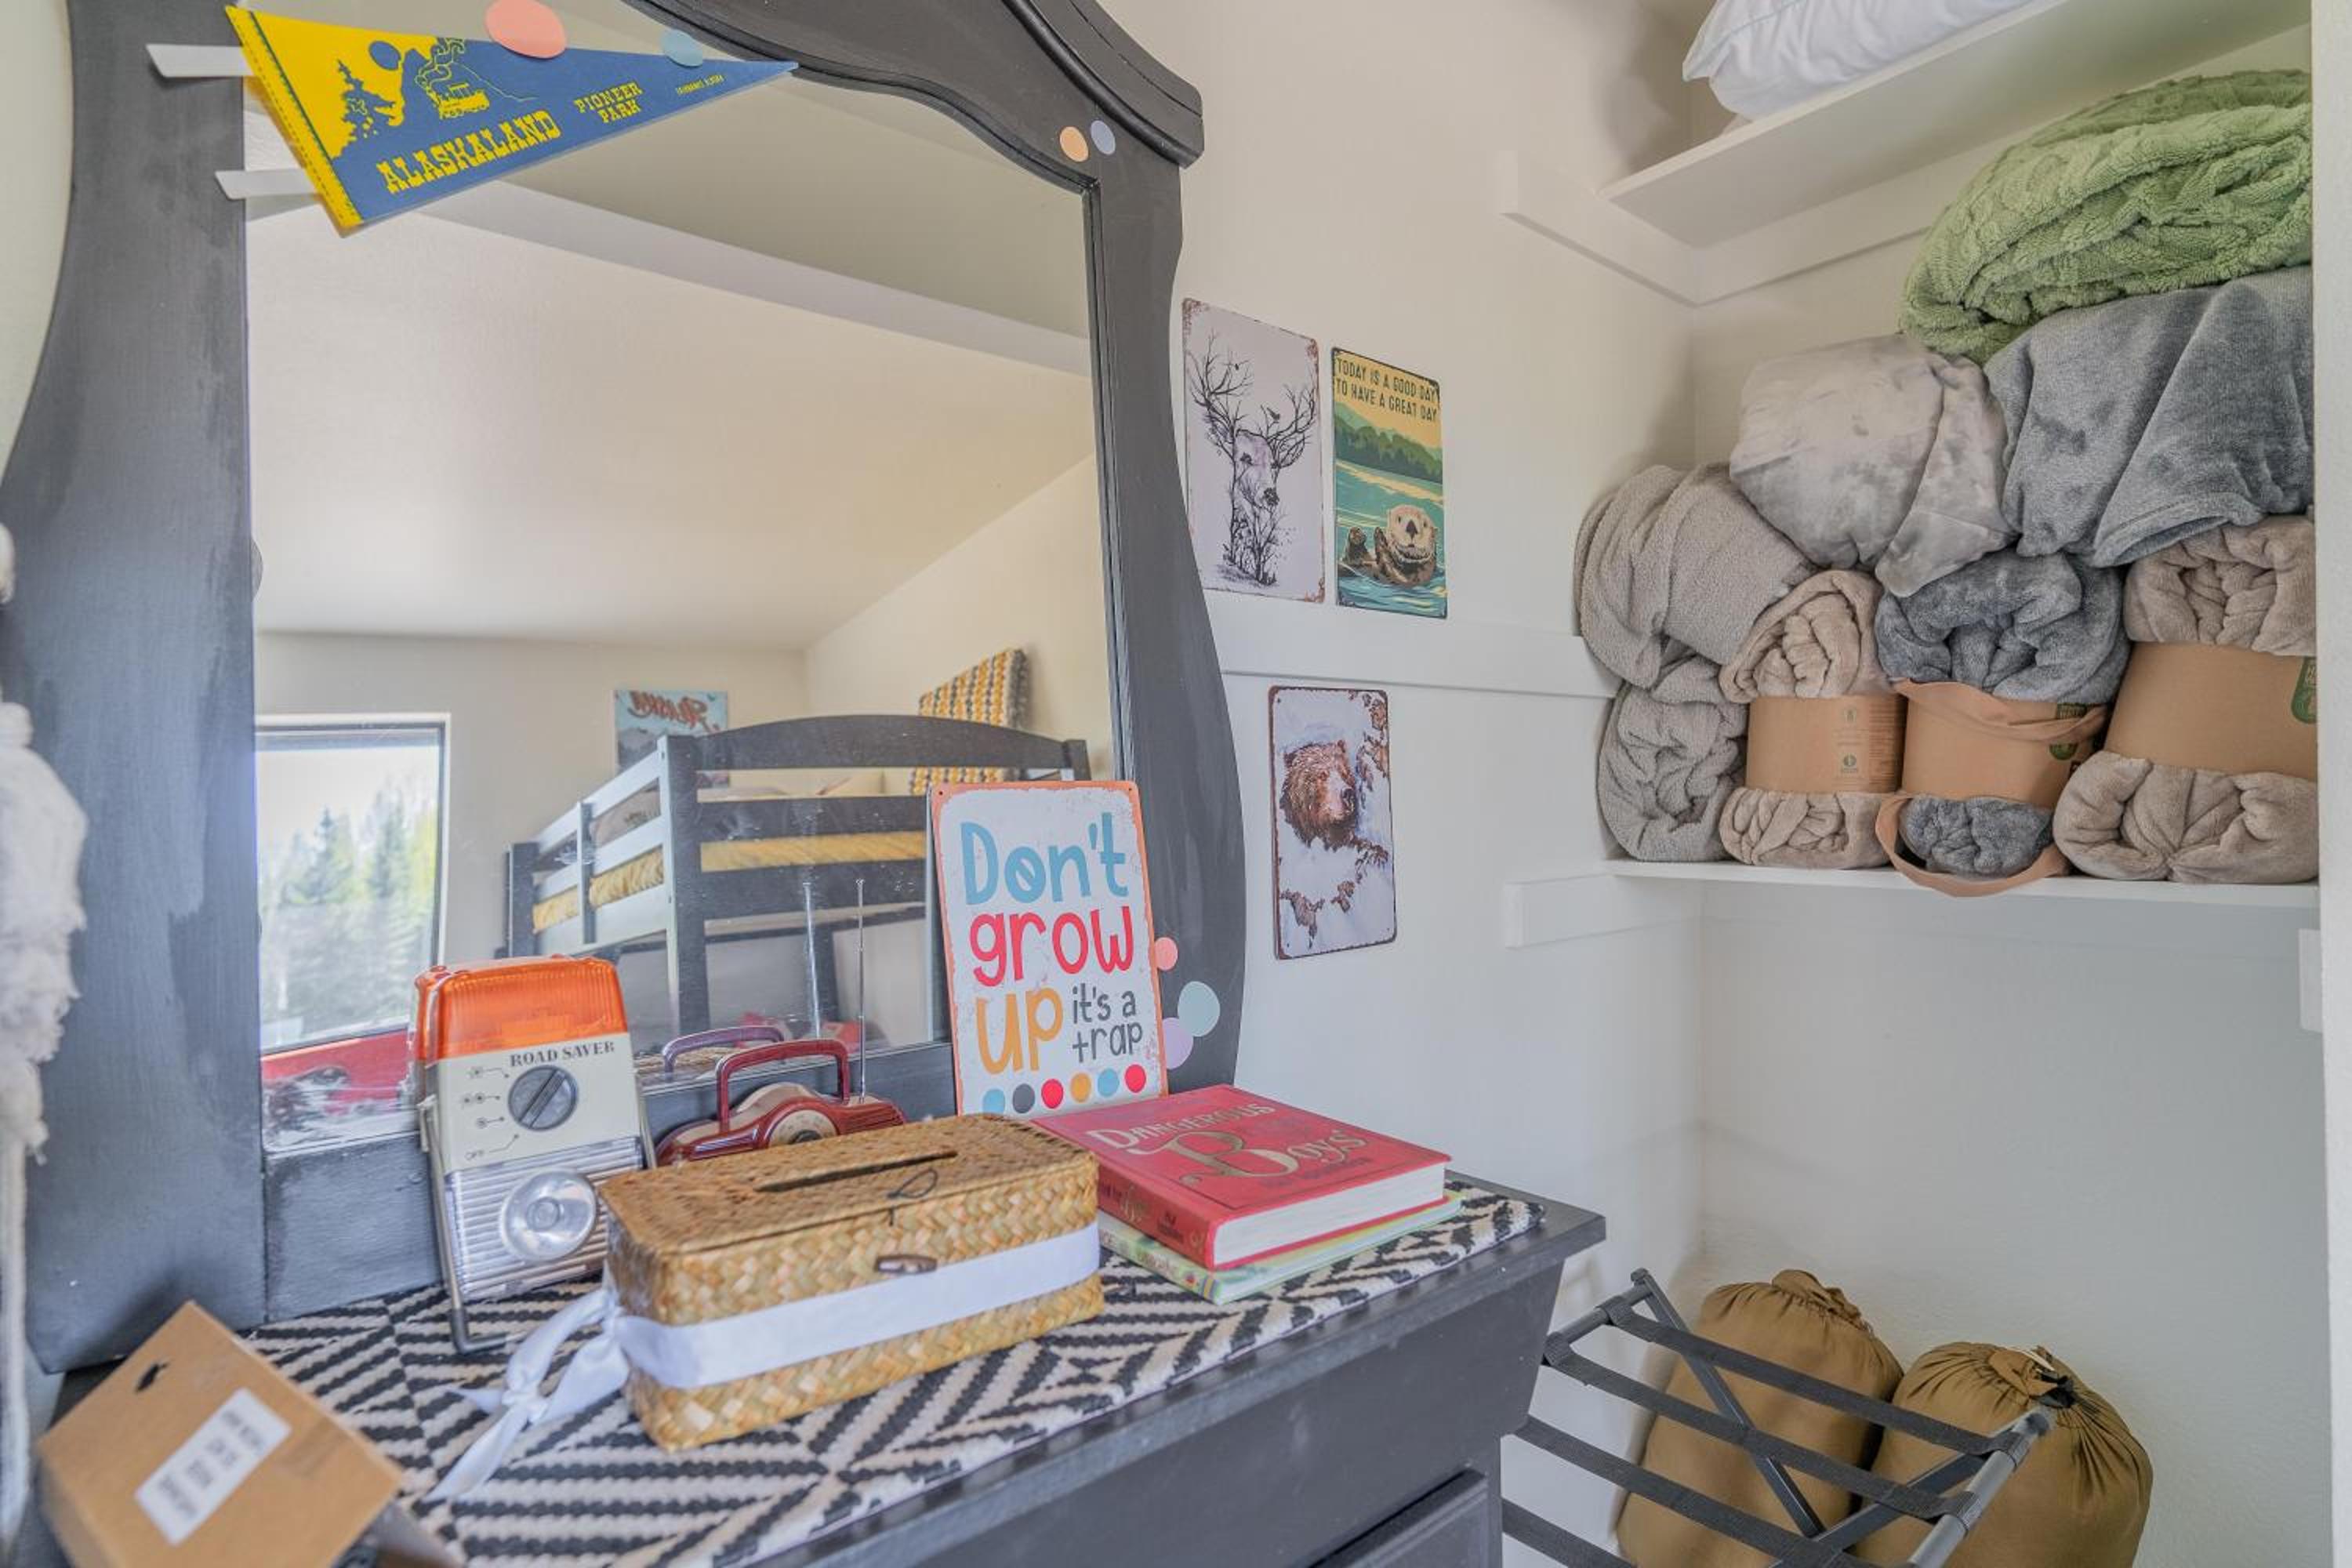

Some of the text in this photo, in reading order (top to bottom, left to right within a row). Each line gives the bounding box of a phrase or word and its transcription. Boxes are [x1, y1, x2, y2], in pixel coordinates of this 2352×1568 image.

[573, 82, 642, 113] PIONEER
[598, 100, 641, 123] PARK
[376, 110, 561, 194] ALASKALAND
[1336, 358, 1436, 401] TODAY IS A GOOD DAY
[1336, 378, 1437, 421] TO HAVE A GREAT DAY
[960, 812, 1129, 905] Don't
[970, 906, 1134, 986] grow
[1072, 983, 1136, 1024] it's a
[510, 1041, 615, 1067] ROAD SAVER
[1072, 1022, 1142, 1063] trap
[1085, 1103, 1276, 1149] DANGEROUS
